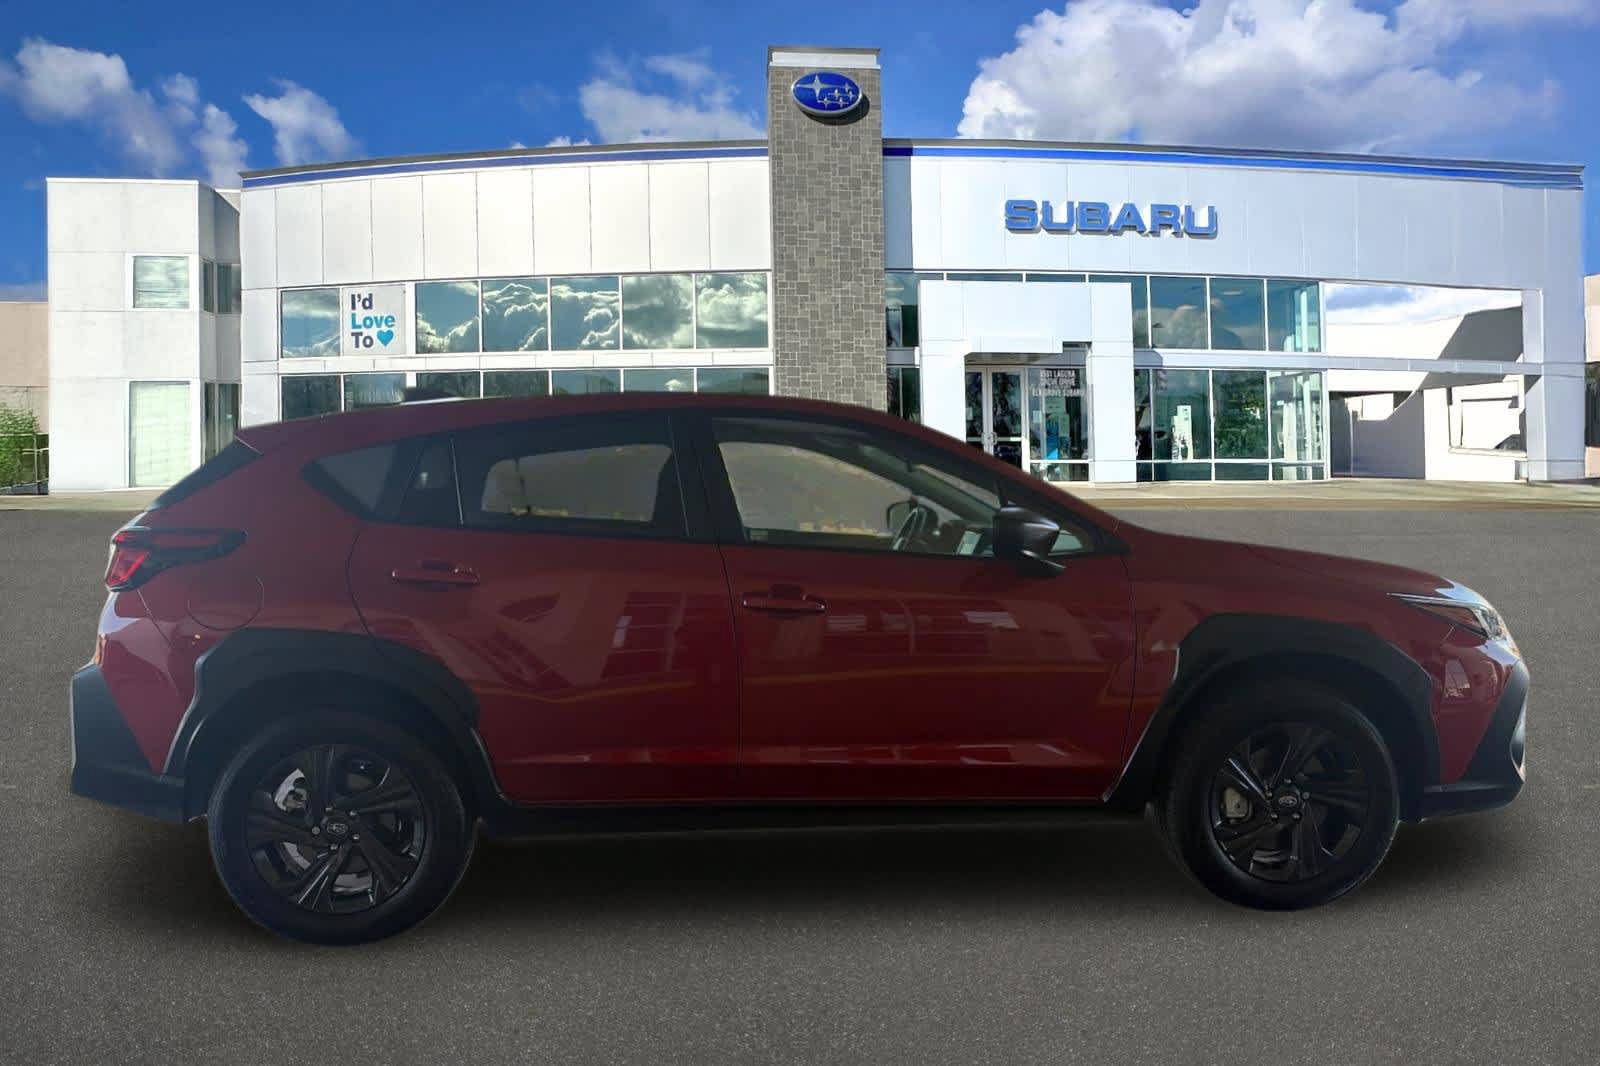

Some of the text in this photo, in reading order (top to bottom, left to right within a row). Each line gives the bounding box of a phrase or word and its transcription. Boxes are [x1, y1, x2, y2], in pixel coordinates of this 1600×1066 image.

[1005, 199, 1218, 239] SUBARU
[351, 293, 373, 310] I'd
[351, 313, 396, 329] Love
[350, 331, 374, 348] To
